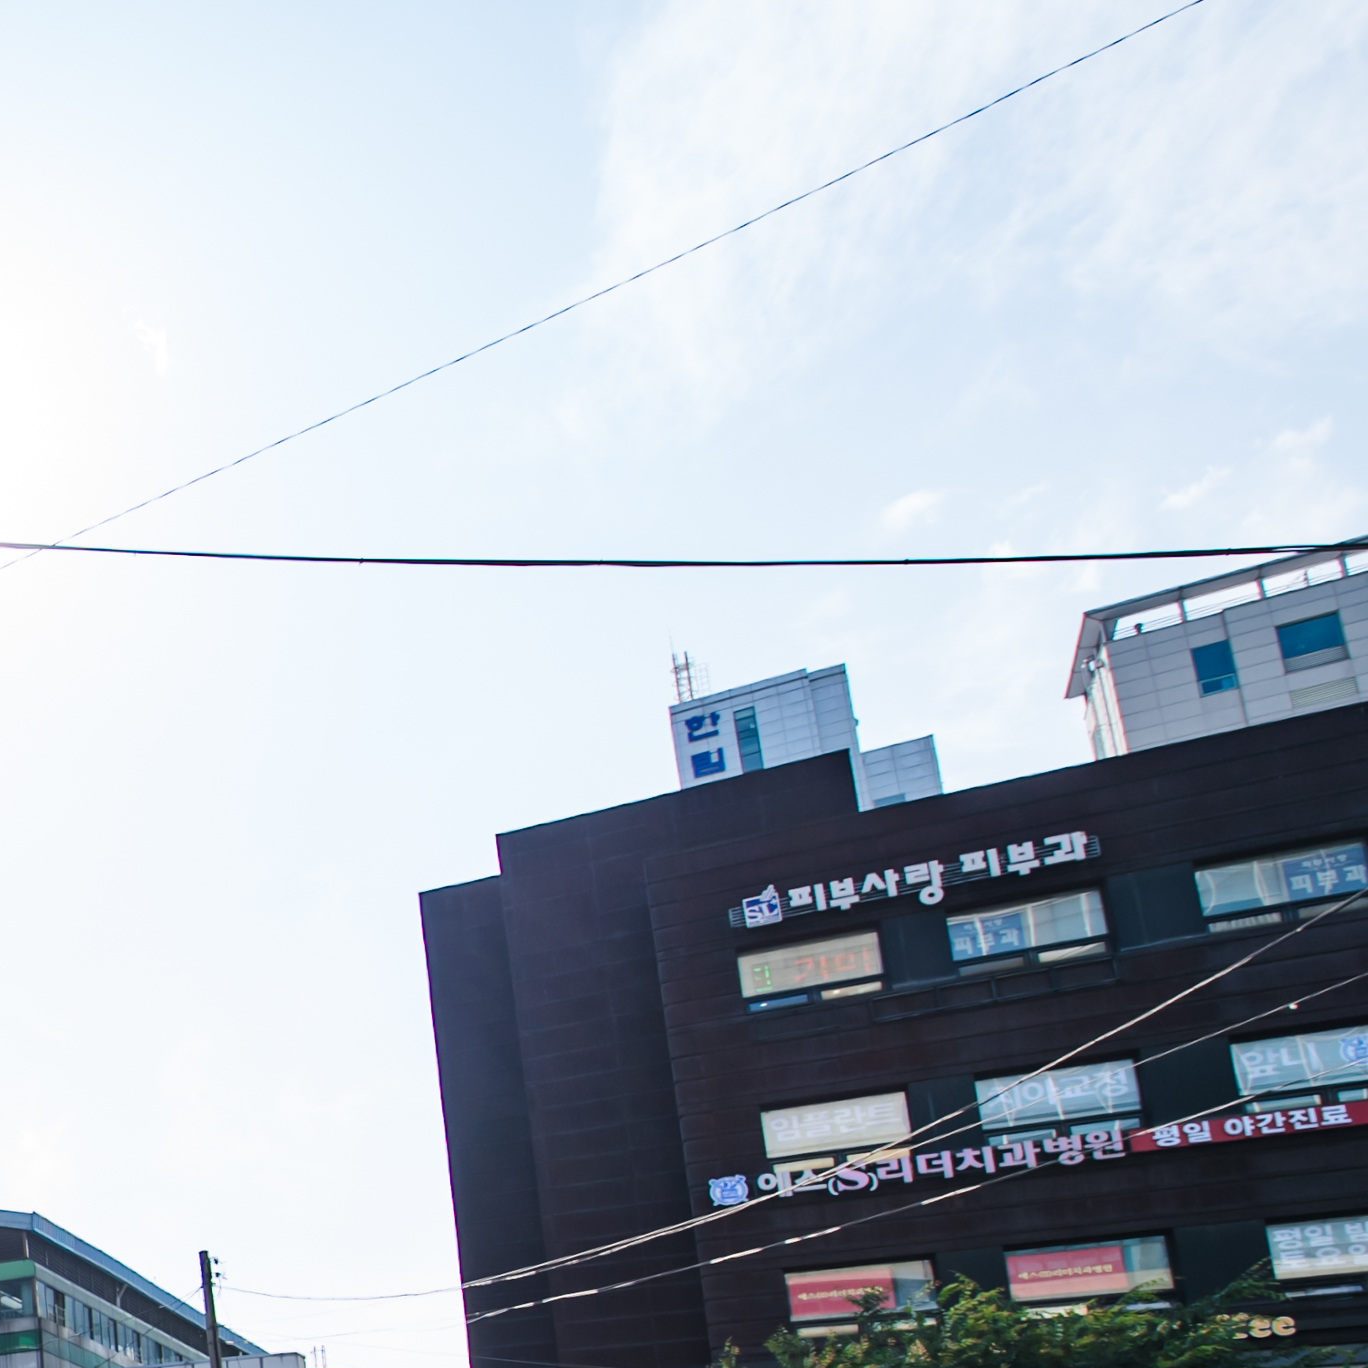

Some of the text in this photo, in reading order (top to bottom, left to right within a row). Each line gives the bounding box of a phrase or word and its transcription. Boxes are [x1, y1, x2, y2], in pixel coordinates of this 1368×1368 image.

[787, 830, 1090, 906] 피부사랑 피부과
[1289, 864, 1367, 895] 피부과
[952, 926, 1021, 956] 피부과
[986, 1068, 1131, 1110] 치아교정
[768, 1100, 903, 1142] 임플란트
[1151, 1119, 1213, 1147] 평일
[1272, 1223, 1335, 1251] 평일
